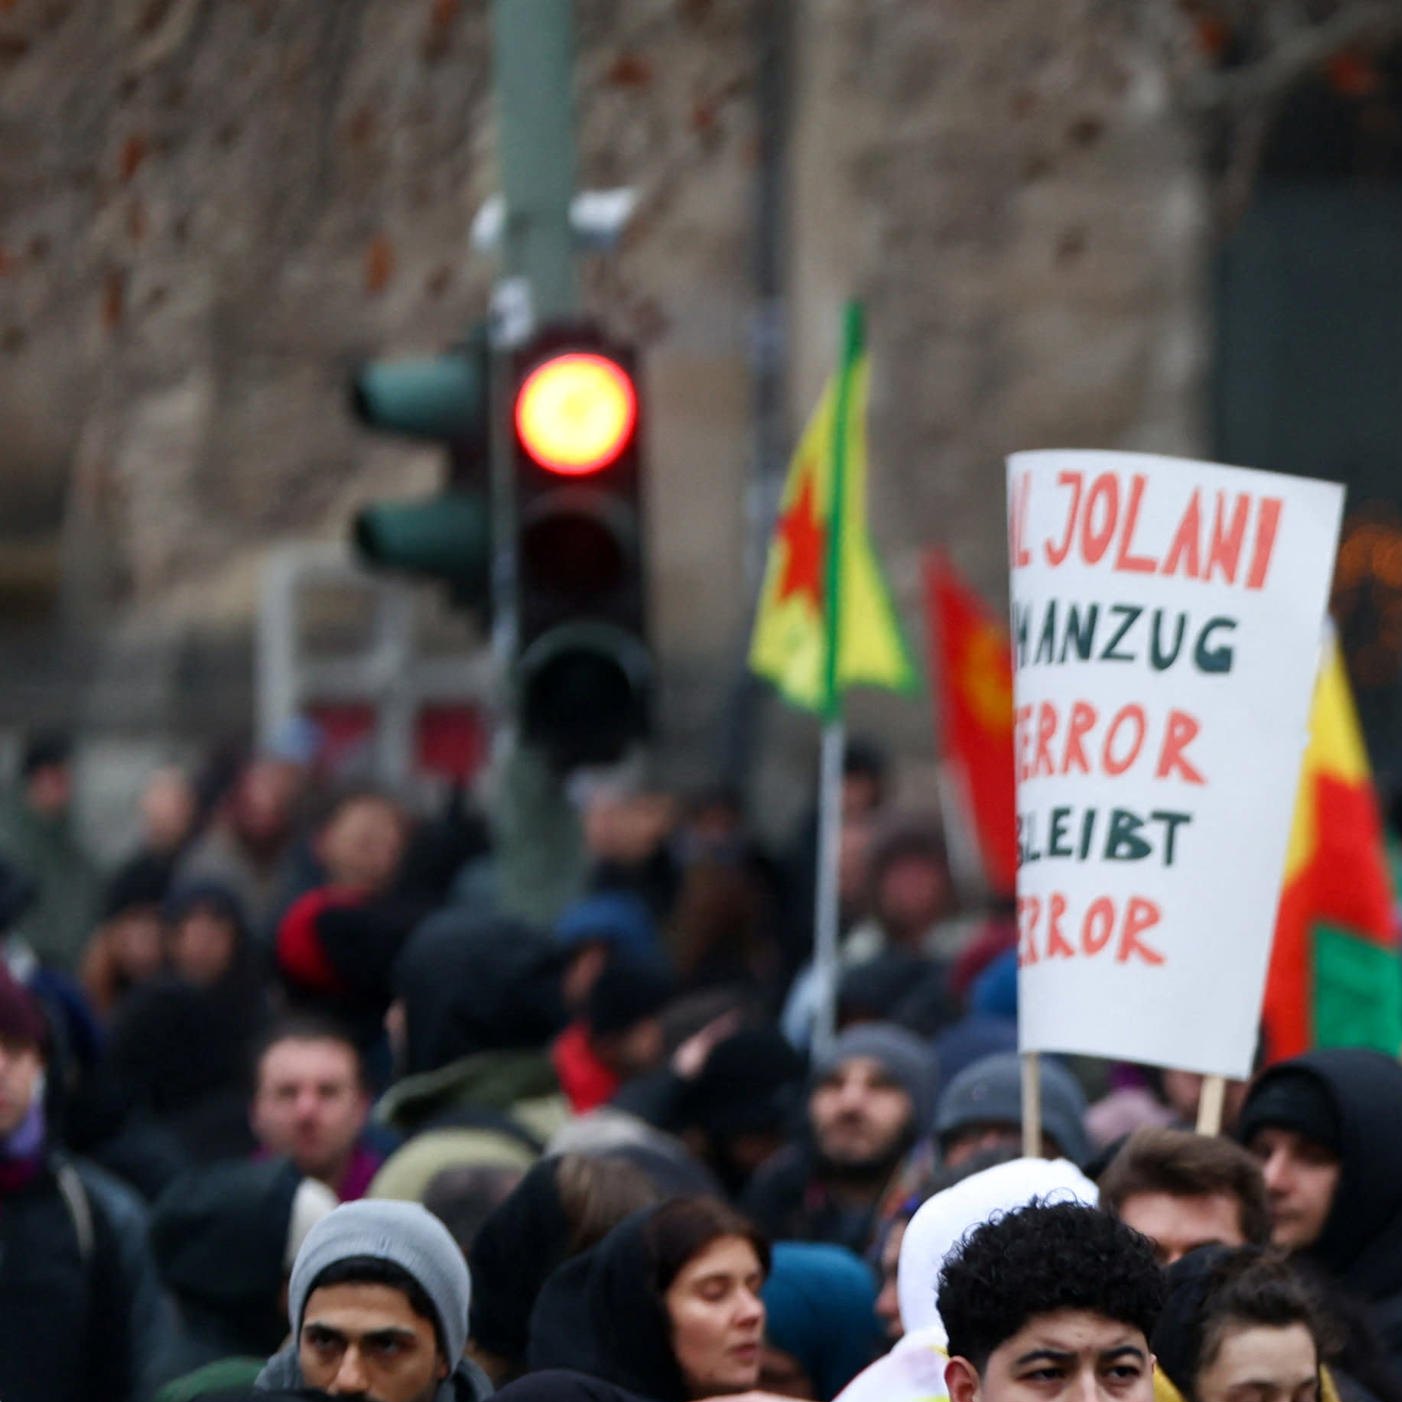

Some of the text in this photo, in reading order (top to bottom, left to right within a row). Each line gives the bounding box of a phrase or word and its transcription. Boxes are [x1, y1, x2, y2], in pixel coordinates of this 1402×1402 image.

[1044, 470, 1284, 592] JOLANI
[1035, 598, 1239, 674] ANZUG
[1015, 700, 1207, 786] ERROR
